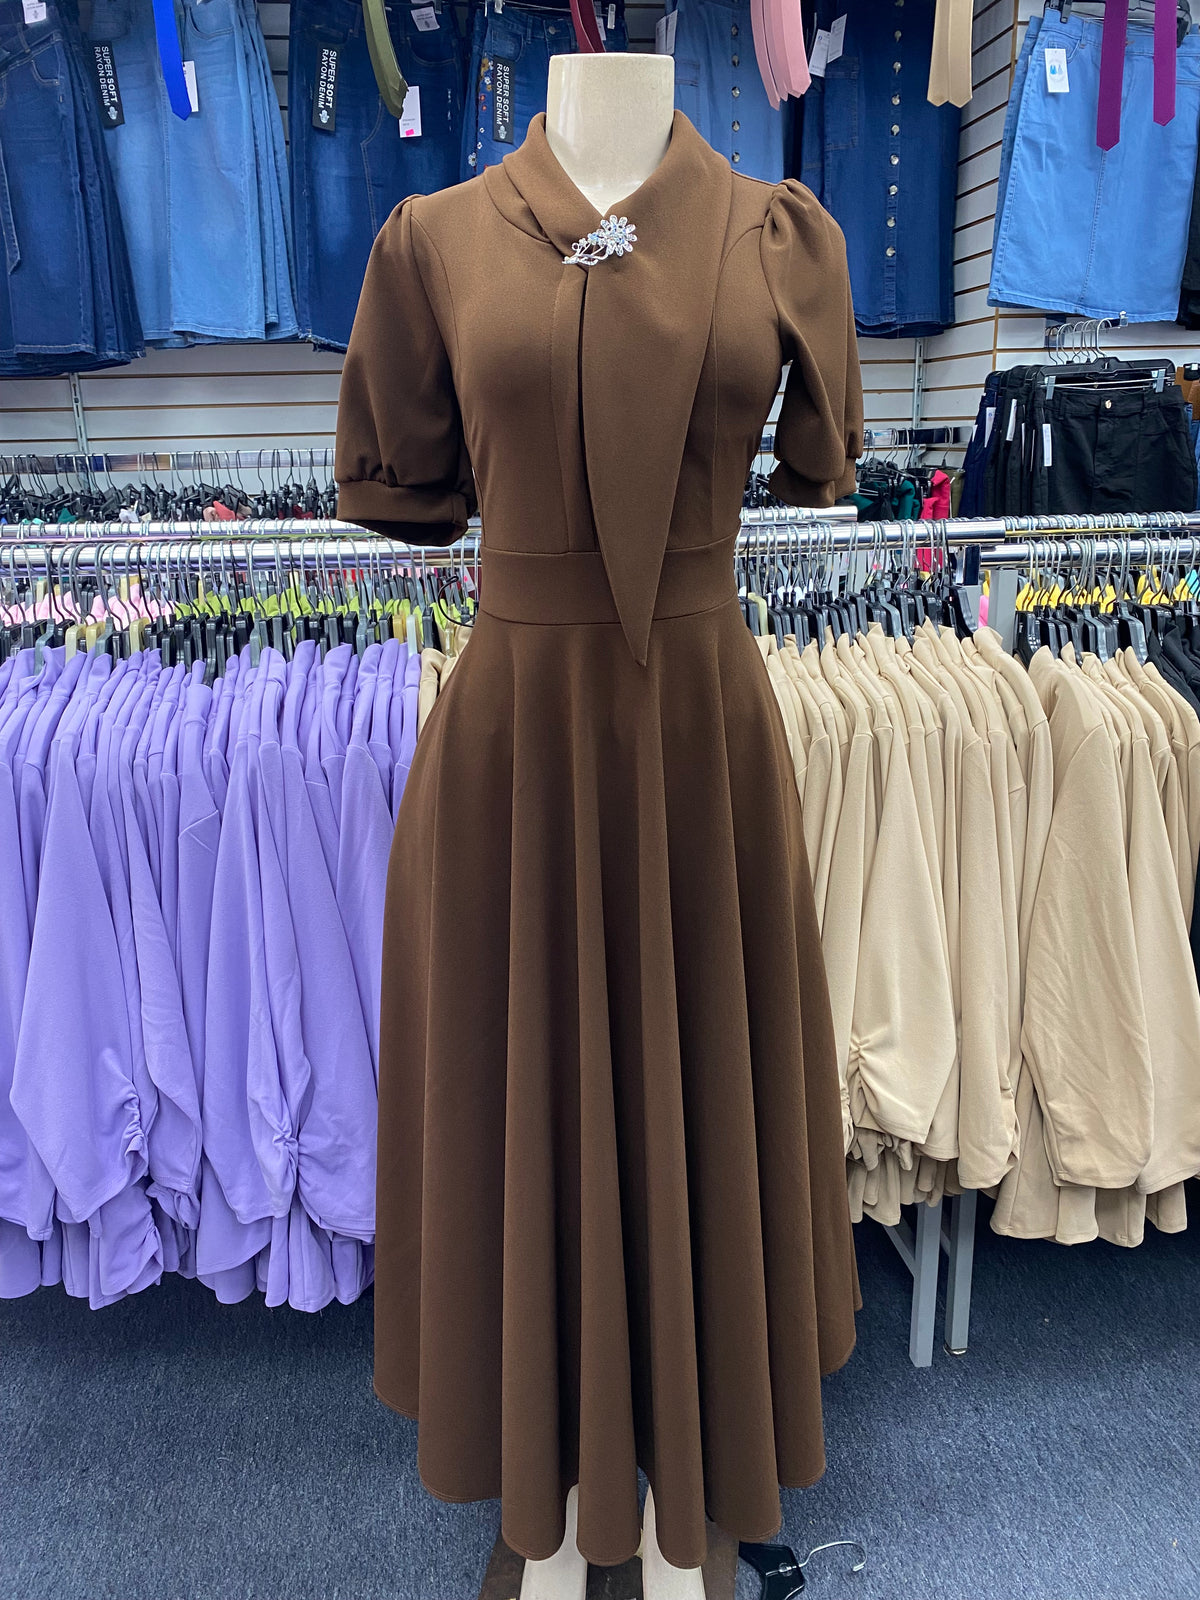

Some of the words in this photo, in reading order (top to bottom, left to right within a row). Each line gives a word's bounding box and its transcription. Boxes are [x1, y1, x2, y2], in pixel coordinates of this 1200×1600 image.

[94, 46, 105, 77] RAYON
[101, 46, 113, 77] SUPER
[107, 78, 118, 103] SOFT
[320, 48, 329, 80] RAYON
[327, 50, 337, 82] SUPER
[99, 77, 111, 106] DENIM
[318, 80, 327, 109] DENIM
[325, 83, 335, 109] SOFT
[502, 65, 510, 97] SUPER
[502, 97, 510, 123] SOFT
